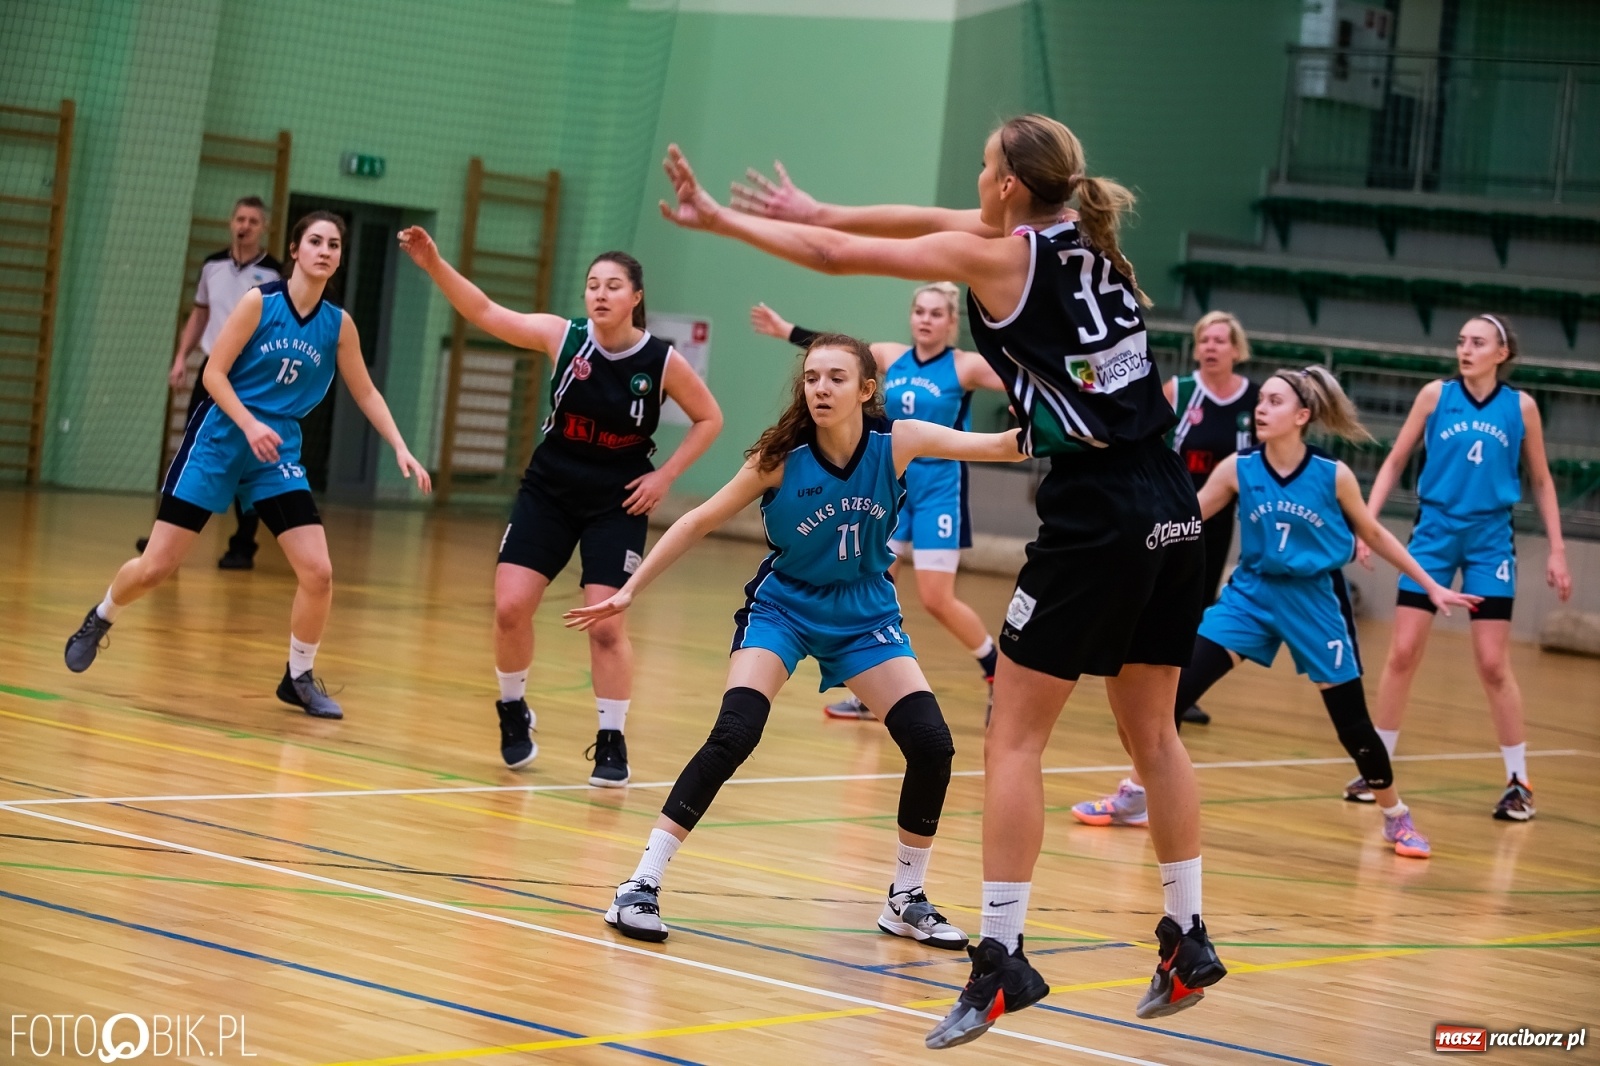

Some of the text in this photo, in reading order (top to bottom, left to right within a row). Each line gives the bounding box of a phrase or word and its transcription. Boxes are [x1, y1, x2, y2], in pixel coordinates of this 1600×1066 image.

[1057, 248, 1140, 345] 35
[260, 337, 289, 356] MLKS
[275, 357, 303, 385] 15
[629, 398, 645, 427] 4
[901, 390, 916, 415] 9
[1466, 439, 1484, 465] 4
[796, 496, 887, 537] MLKS RZESÓW
[937, 513, 953, 539] 9
[837, 522, 862, 561] 11
[1275, 522, 1292, 553] 7
[1495, 559, 1510, 583] 4
[1327, 639, 1344, 670] 7
